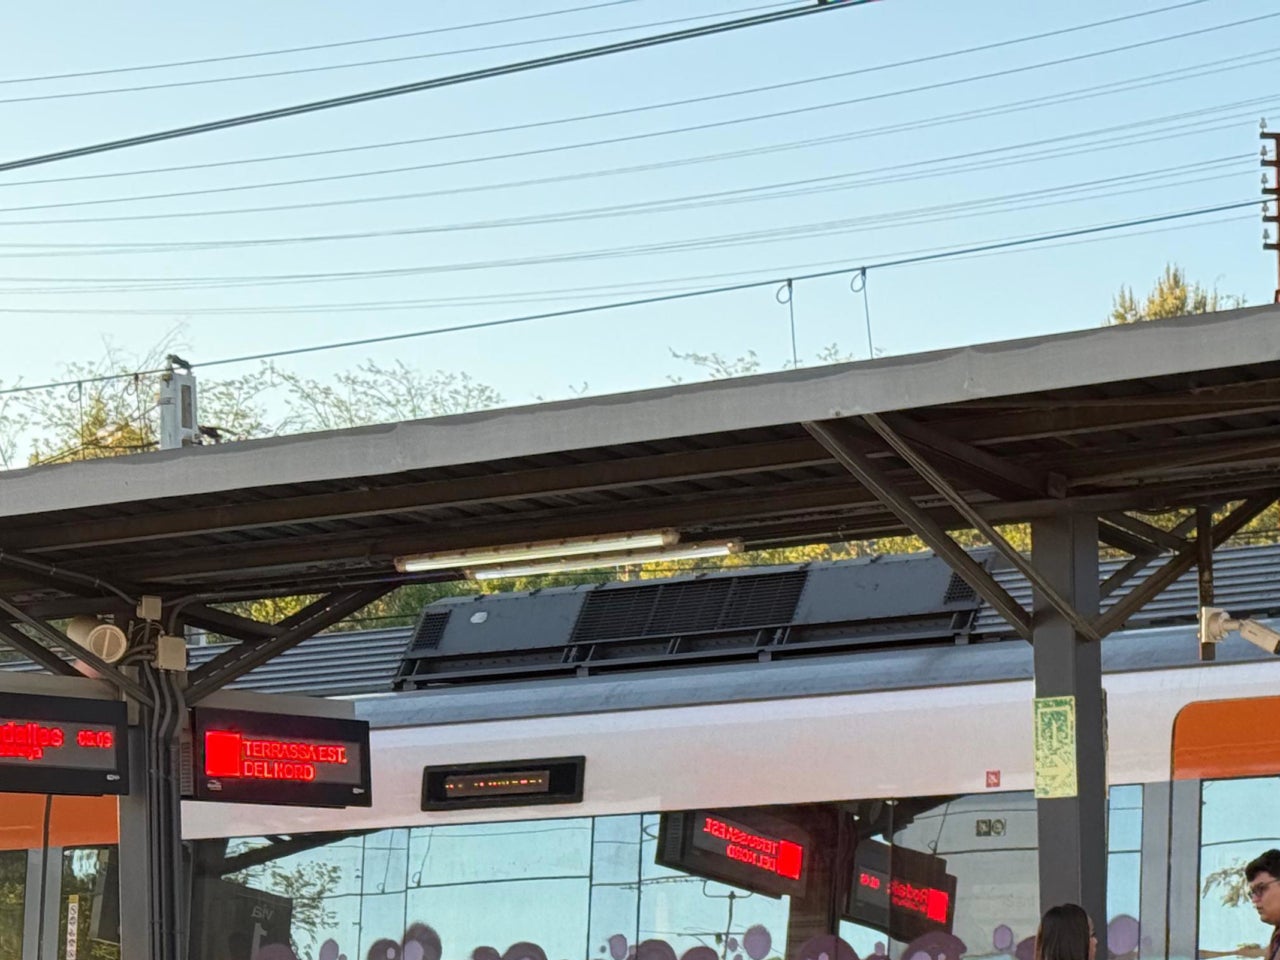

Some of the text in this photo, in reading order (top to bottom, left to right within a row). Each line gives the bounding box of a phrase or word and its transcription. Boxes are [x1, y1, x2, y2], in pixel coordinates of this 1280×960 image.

[242, 741, 317, 761] TERRASSA
[244, 761, 315, 780] DEL NORD
